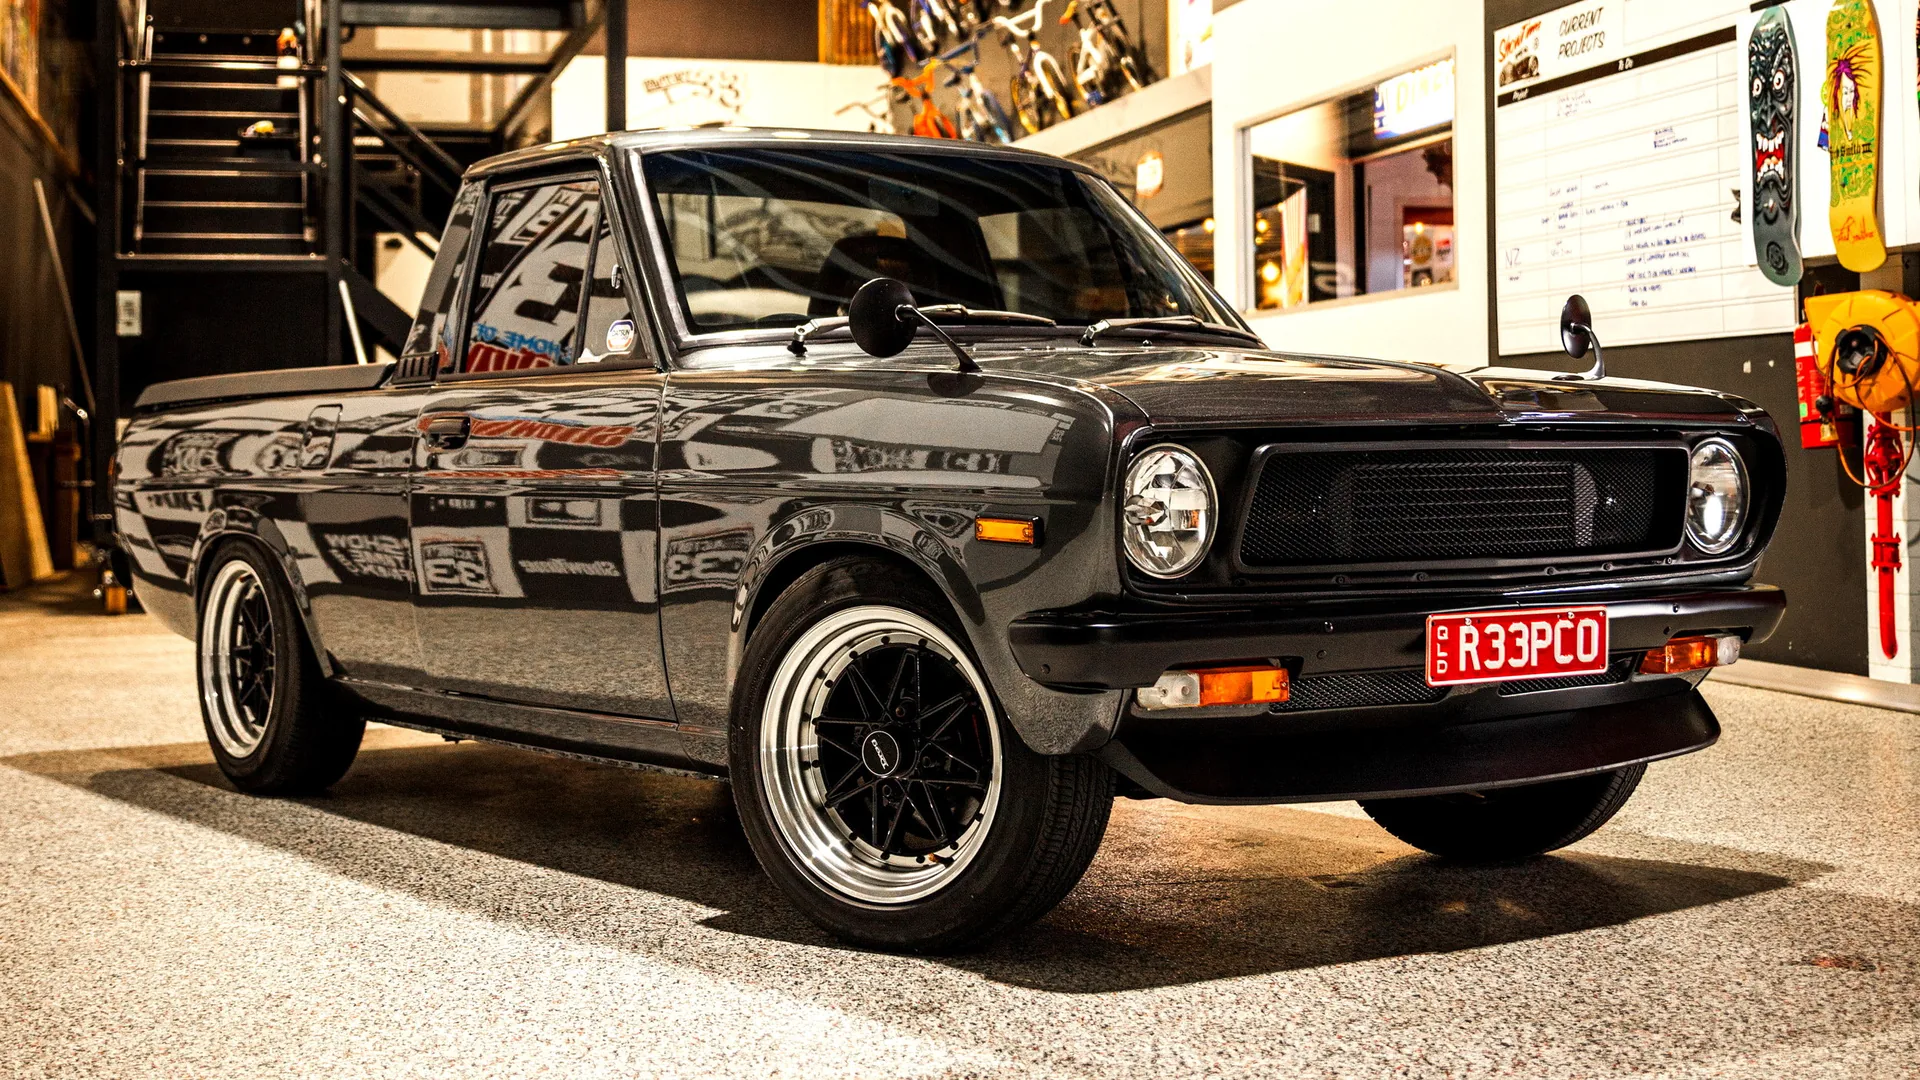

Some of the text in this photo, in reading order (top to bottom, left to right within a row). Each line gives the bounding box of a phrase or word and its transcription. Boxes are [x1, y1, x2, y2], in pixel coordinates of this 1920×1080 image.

[1559, 7, 1604, 37] CURRENT
[1558, 31, 1605, 60] PROJECTS
[1436, 625, 1449, 675] QLD
[1458, 617, 1600, 673] R33PCO
